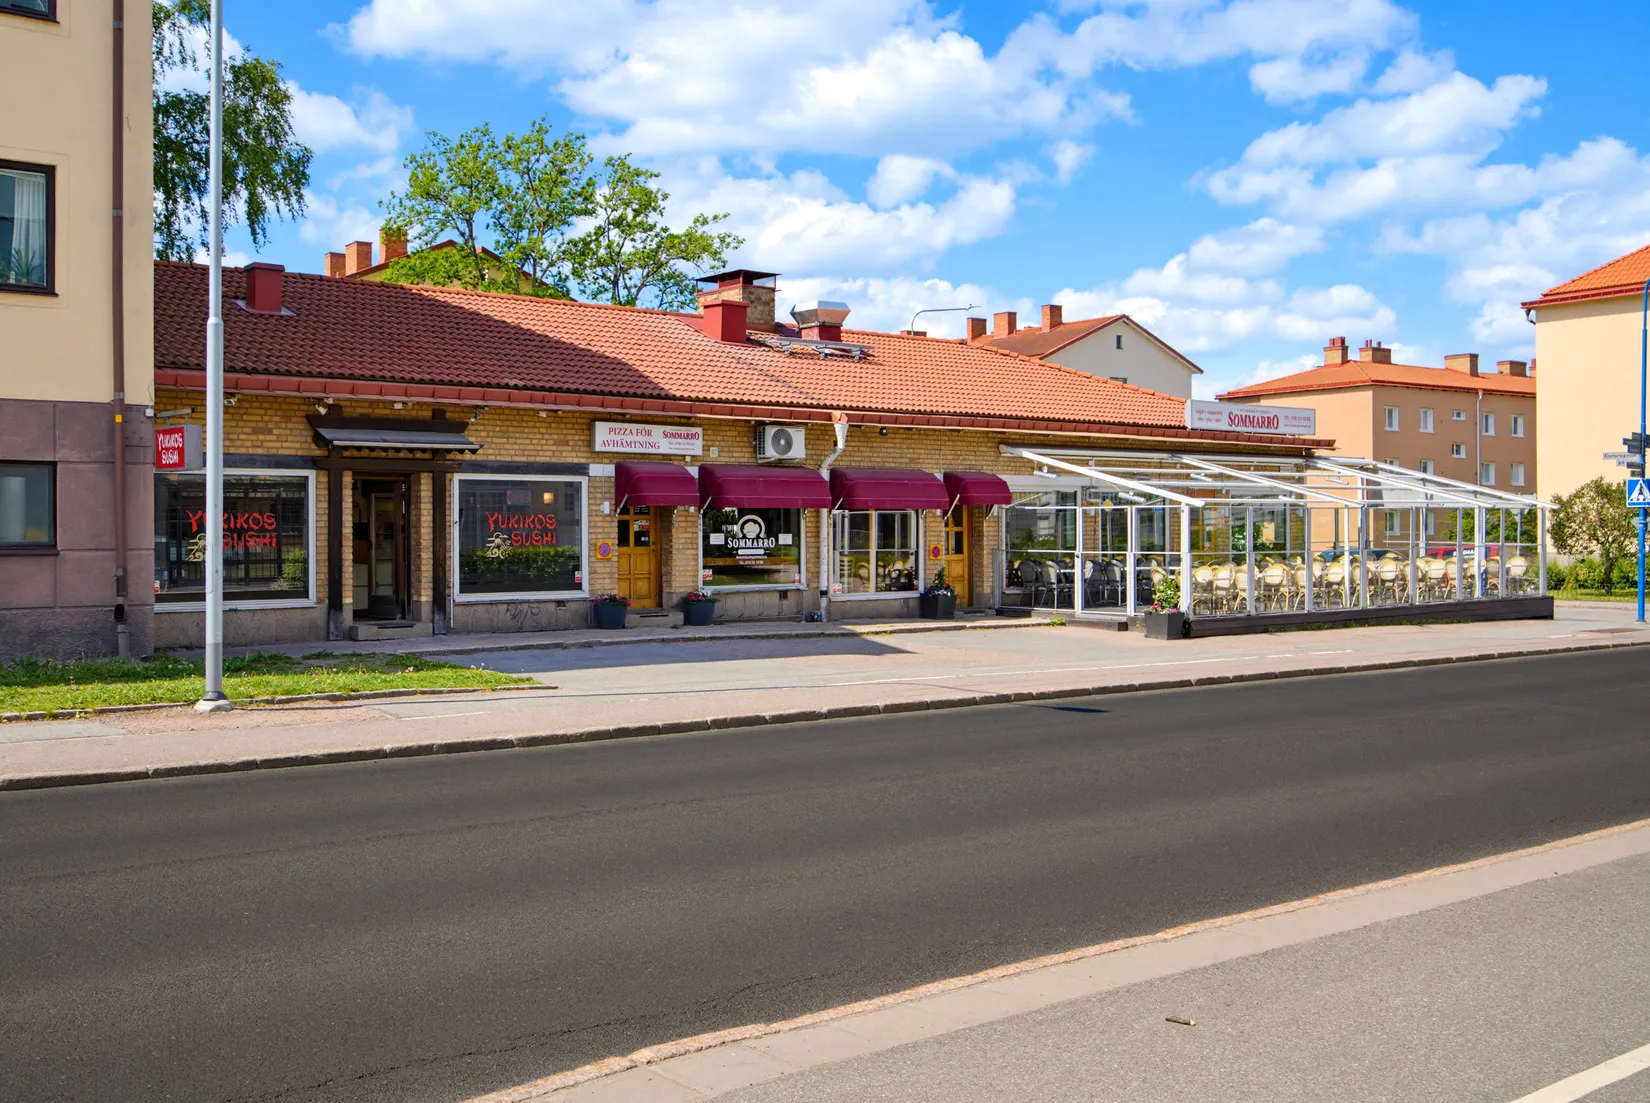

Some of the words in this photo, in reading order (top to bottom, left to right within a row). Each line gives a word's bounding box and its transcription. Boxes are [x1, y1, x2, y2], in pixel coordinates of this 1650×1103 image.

[1228, 411, 1279, 430] SOMMARRO
[608, 427, 634, 437] PIZZA
[636, 426, 653, 437] FÖR
[662, 430, 700, 441] SOMMARRO
[157, 433, 183, 451] YUKIKOS
[600, 438, 660, 450] AVHÄMTNING
[162, 450, 179, 464] SUSHI
[186, 510, 277, 533] YIKOS
[485, 511, 557, 532] YUKIKOS
[223, 531, 277, 549] SUSHI
[511, 530, 557, 547] SUSHI
[727, 537, 776, 548] SOMMARRO
